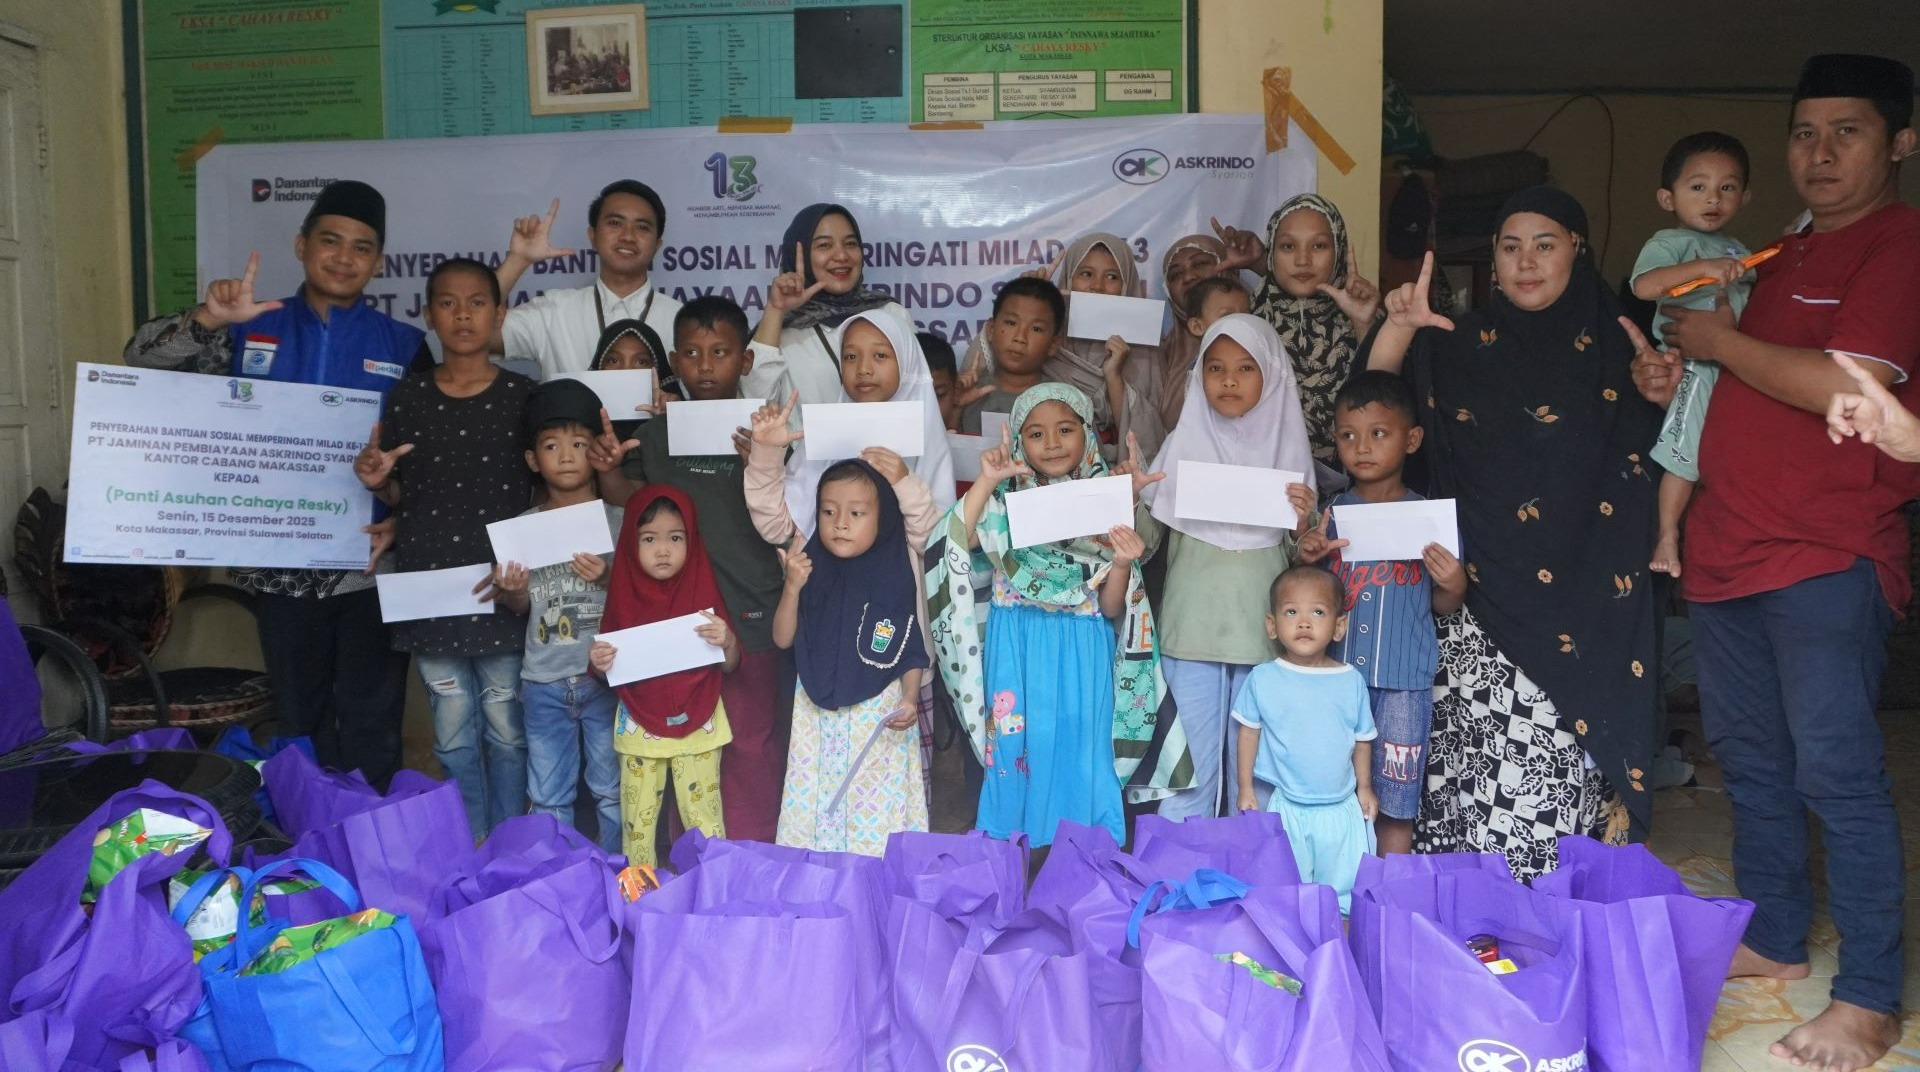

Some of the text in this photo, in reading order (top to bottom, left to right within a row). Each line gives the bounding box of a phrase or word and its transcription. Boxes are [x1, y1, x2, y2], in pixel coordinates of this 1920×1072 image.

[979, 31, 1026, 41] ORGANISASI
[1027, 30, 1063, 39] YAYASAN
[985, 43, 1012, 53] LKSA
[1174, 156, 1255, 169] ASKRINDO
[704, 151, 758, 202] 13
[274, 190, 318, 202] Indone
[663, 245, 756, 271] SOSIAL
[978, 239, 1064, 266] MILAD
[101, 370, 139, 380] Danantara
[101, 377, 137, 386] Indonesia
[227, 378, 254, 402] 13
[345, 397, 378, 405] ASKRINDO
[90, 421, 158, 435] PENYERAHAN
[161, 427, 207, 439] BANTUAN
[210, 430, 244, 442] SOSIAL
[246, 432, 314, 447] MEMPERINGATI
[316, 439, 343, 449] MILAD
[87, 436, 356, 464] PT JAMINAN PEMBIAYAAN ASKRINDO SYAR
[144, 453, 326, 473] KANTOR CABANG MAKASSAR
[213, 472, 260, 484] KEPADA
[106, 485, 349, 515] (Panti Asuhan Cahaya Resky)
[157, 510, 316, 527] Senin, 15 Desember 2025
[116, 524, 333, 540] Kota Makassar, Provinsi Sulawesi Selatan
[531, 581, 556, 603] THE
[1382, 742, 1422, 781] NY
[1535, 1049, 1586, 1072] ASKRI
